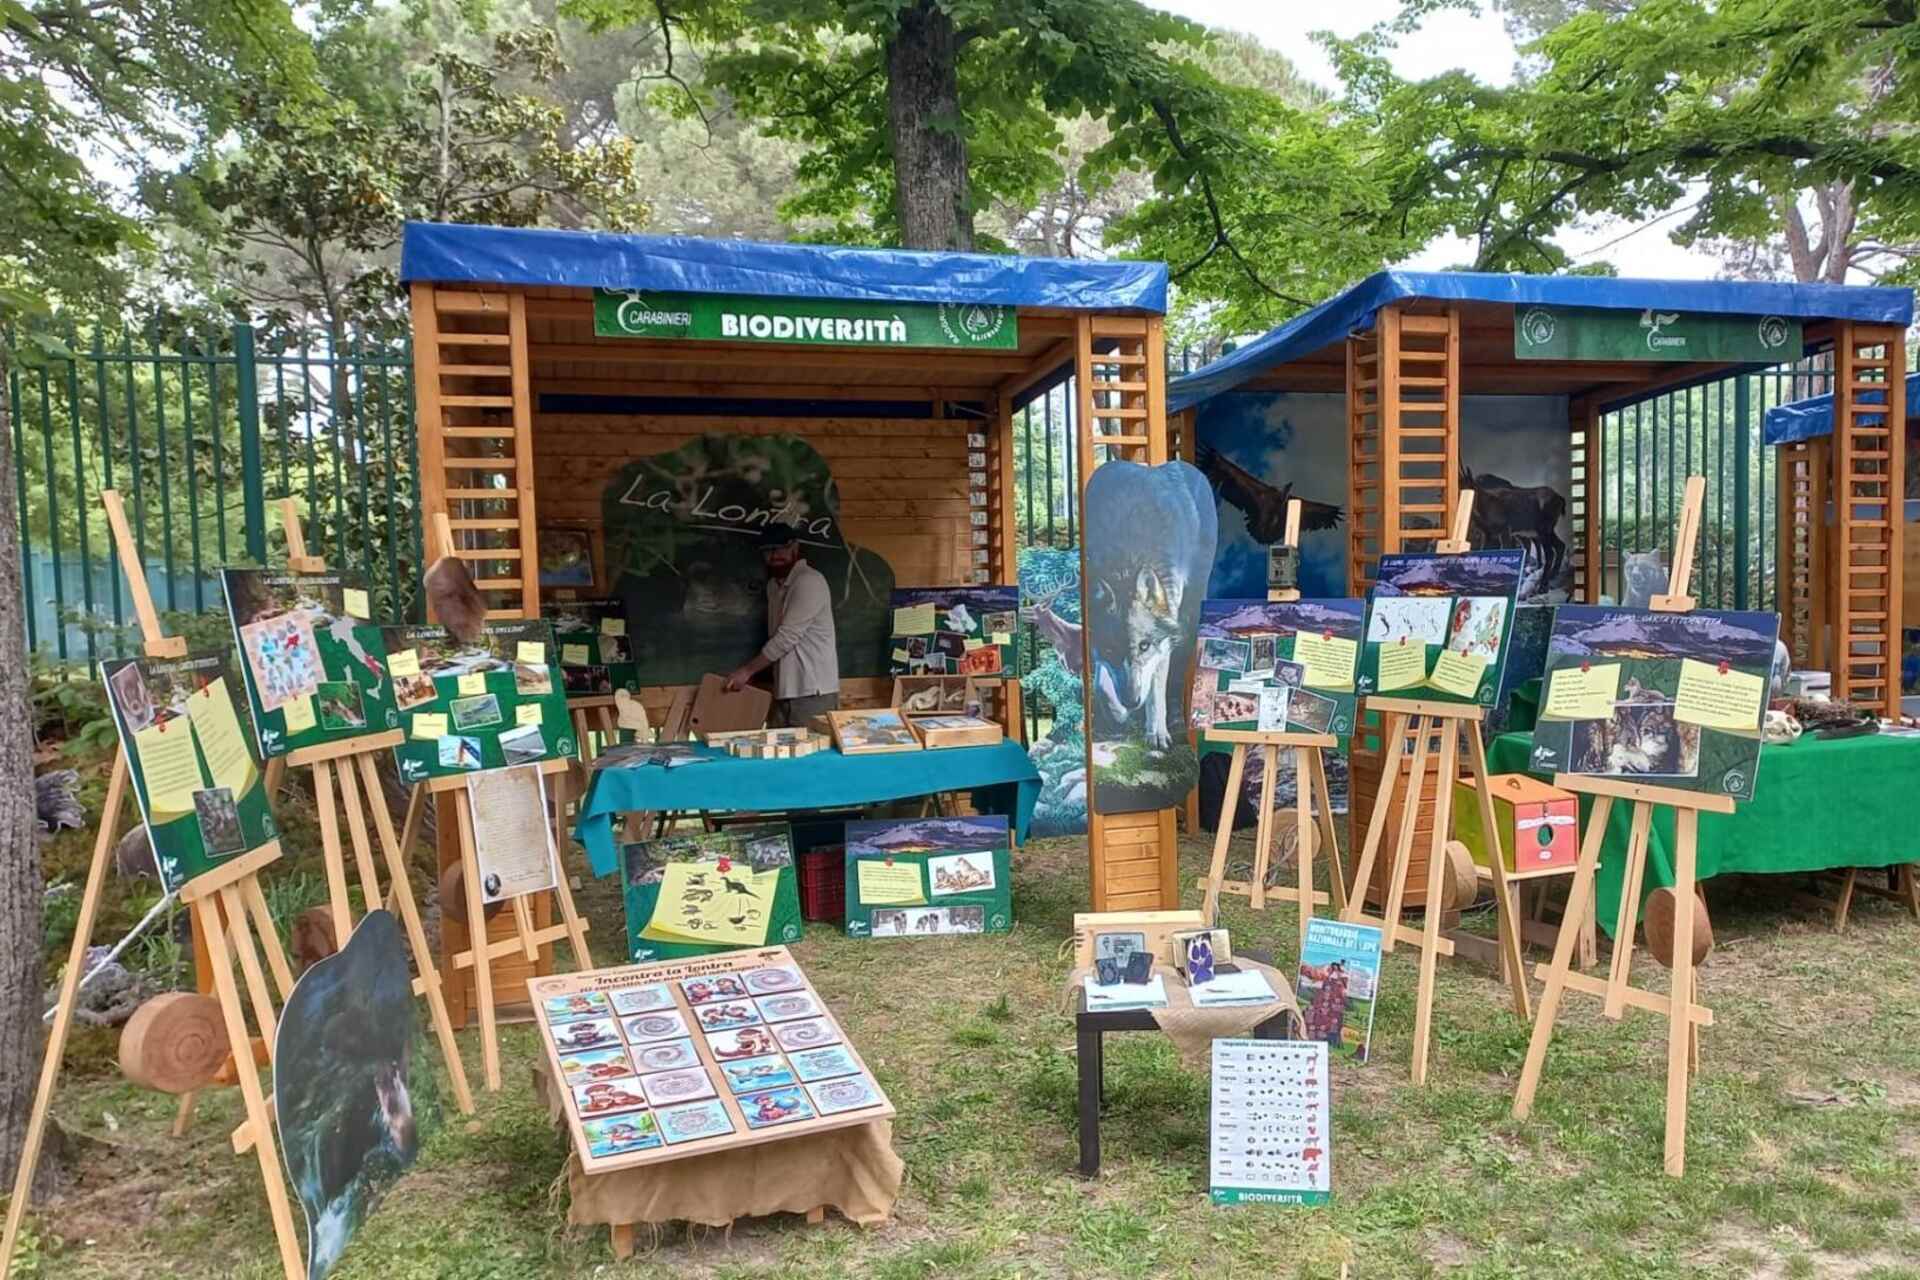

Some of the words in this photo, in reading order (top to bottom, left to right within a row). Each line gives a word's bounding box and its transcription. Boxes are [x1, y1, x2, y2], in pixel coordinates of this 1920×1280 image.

[630, 311, 692, 327] CARABINIERI
[721, 313, 906, 343] BIODIVERSITÀ
[619, 473, 672, 514] La
[691, 485, 833, 539] Lontra
[594, 967, 663, 985] Incontra
[665, 966, 682, 977] la
